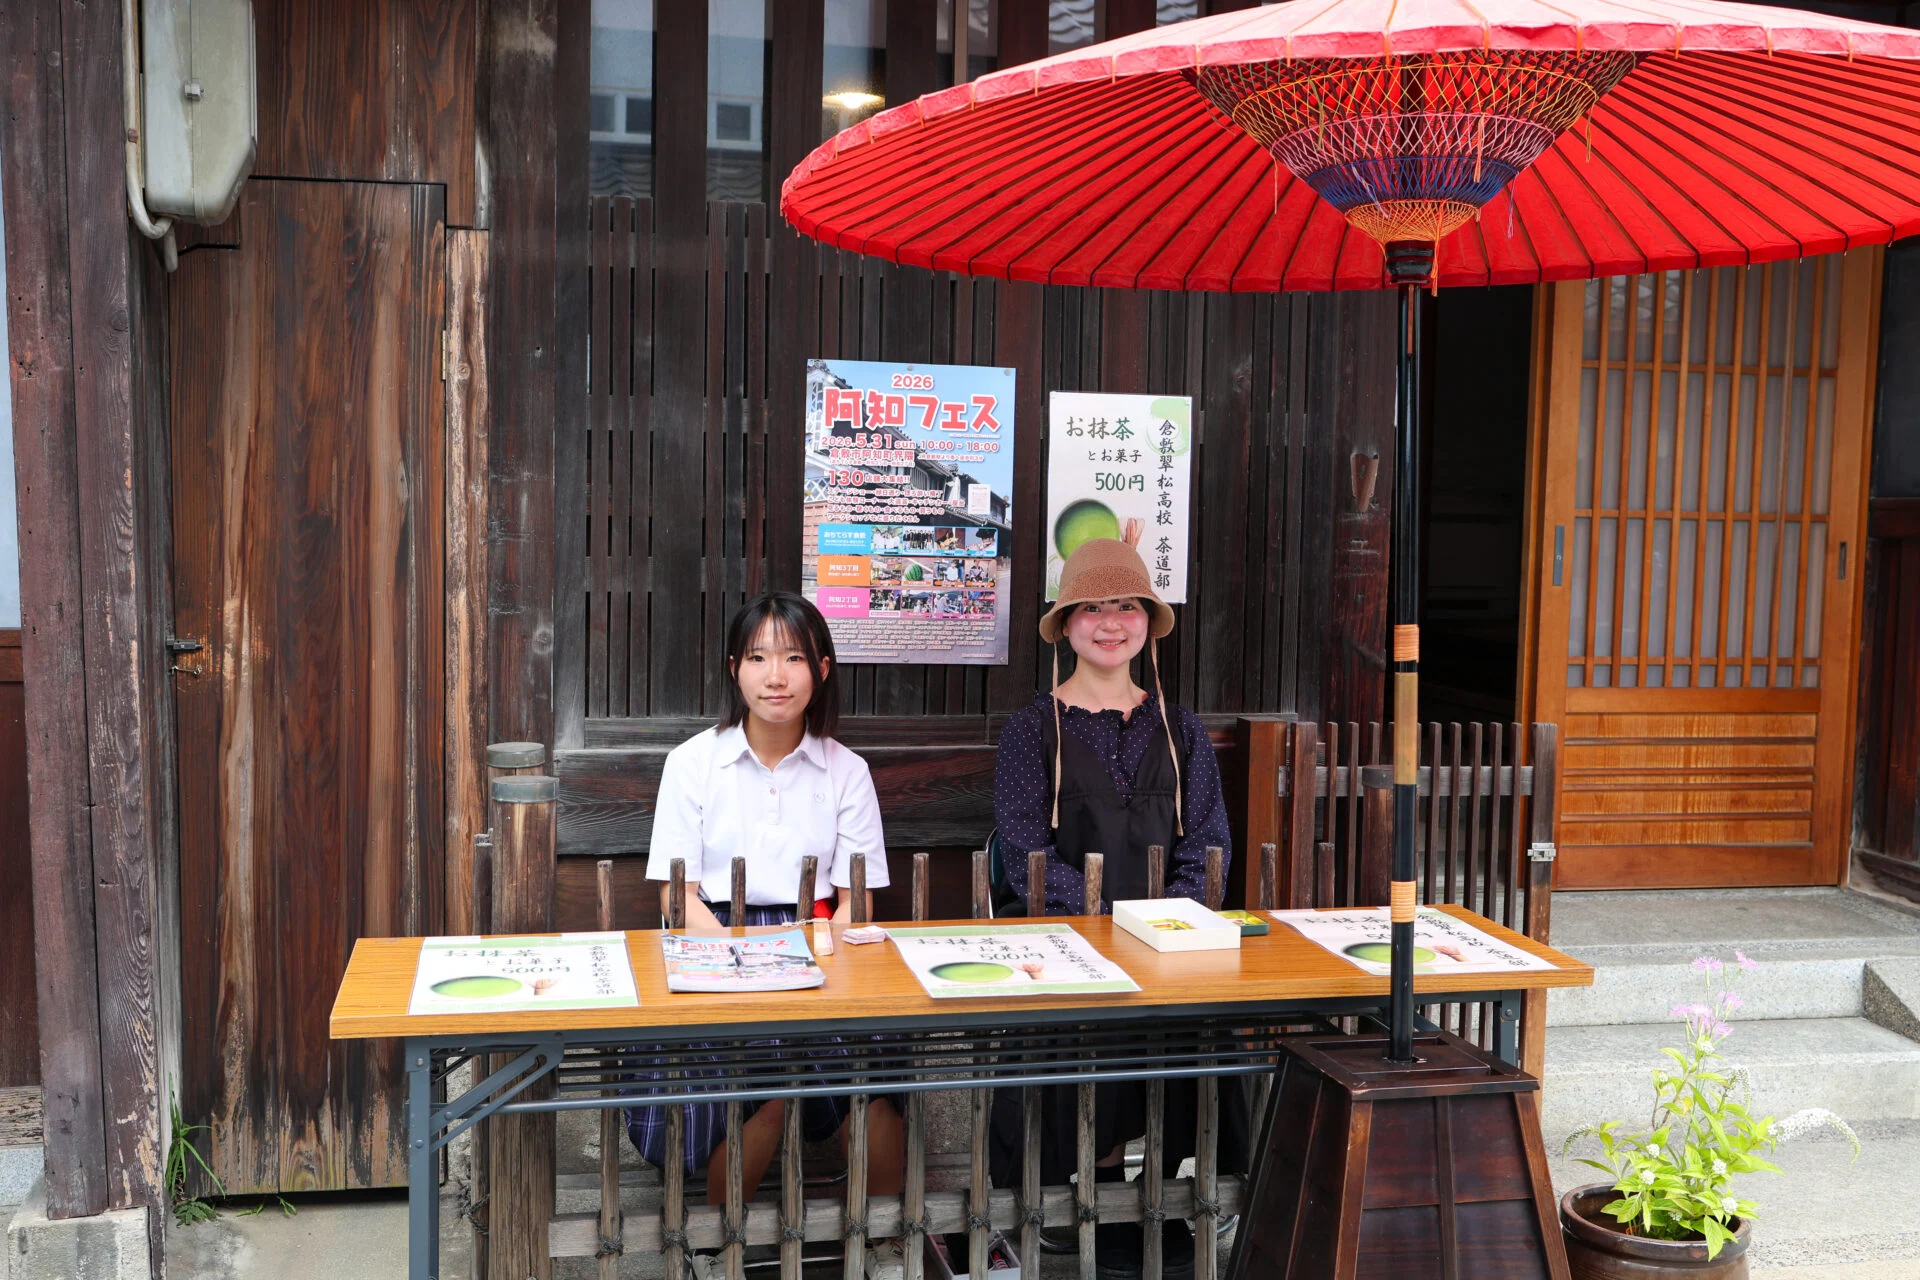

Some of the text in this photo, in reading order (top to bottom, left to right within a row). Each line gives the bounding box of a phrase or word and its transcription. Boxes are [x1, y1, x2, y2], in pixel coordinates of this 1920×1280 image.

[892, 374, 933, 389] 2026
[825, 388, 1000, 431] 阿知フェス
[1066, 416, 1135, 441] お抹茶
[821, 433, 893, 449] 2026.5.31
[894, 440, 916, 449] sun
[920, 440, 954, 450] 10:00
[966, 441, 999, 452] 18:00
[829, 447, 915, 460] 倉敷市阿知町界隈
[1088, 449, 1142, 463] とお菓子
[1095, 472, 1145, 492] 500円
[1154, 536, 1173, 590] 茶道部
